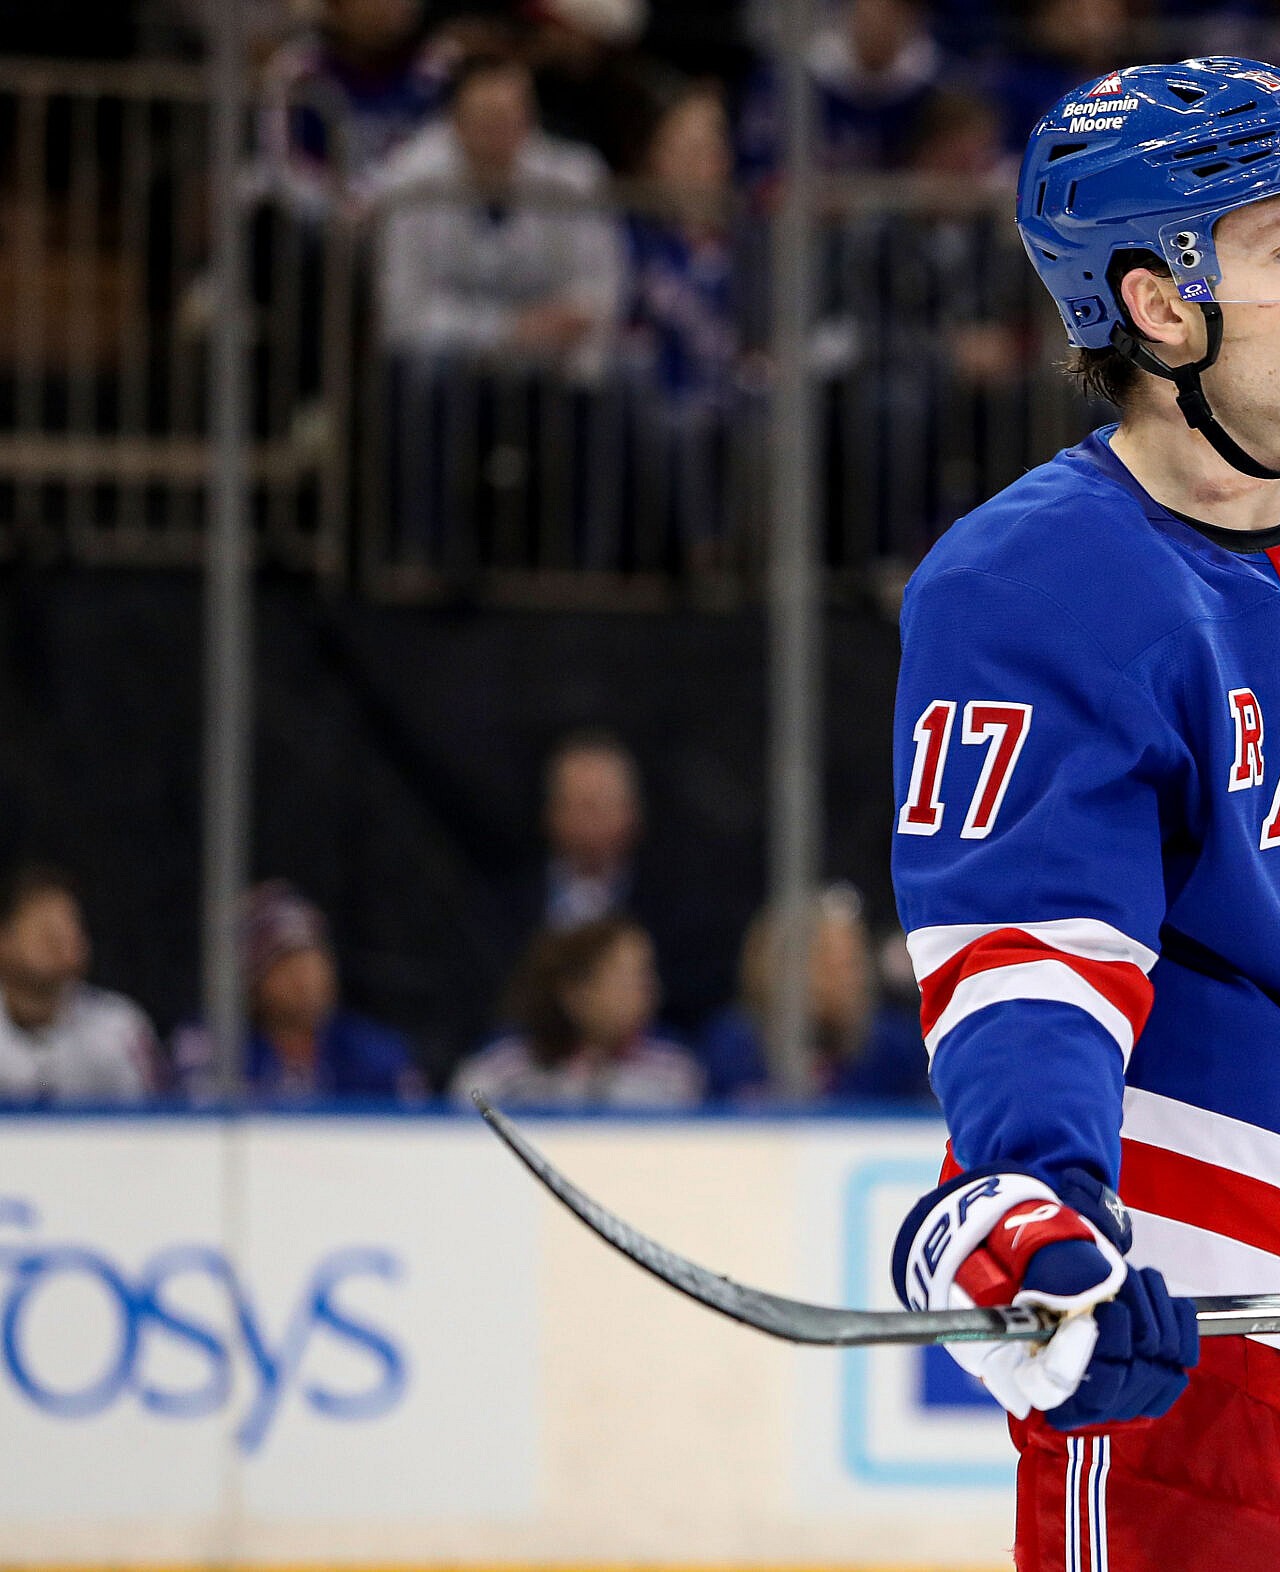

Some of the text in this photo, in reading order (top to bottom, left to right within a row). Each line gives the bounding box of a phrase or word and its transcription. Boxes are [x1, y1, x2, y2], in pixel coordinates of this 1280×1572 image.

[1062, 94, 1139, 118] Benjamin
[1069, 116, 1124, 133] Moore
[897, 699, 1033, 839] 17
[0, 1196, 412, 1454] osys
